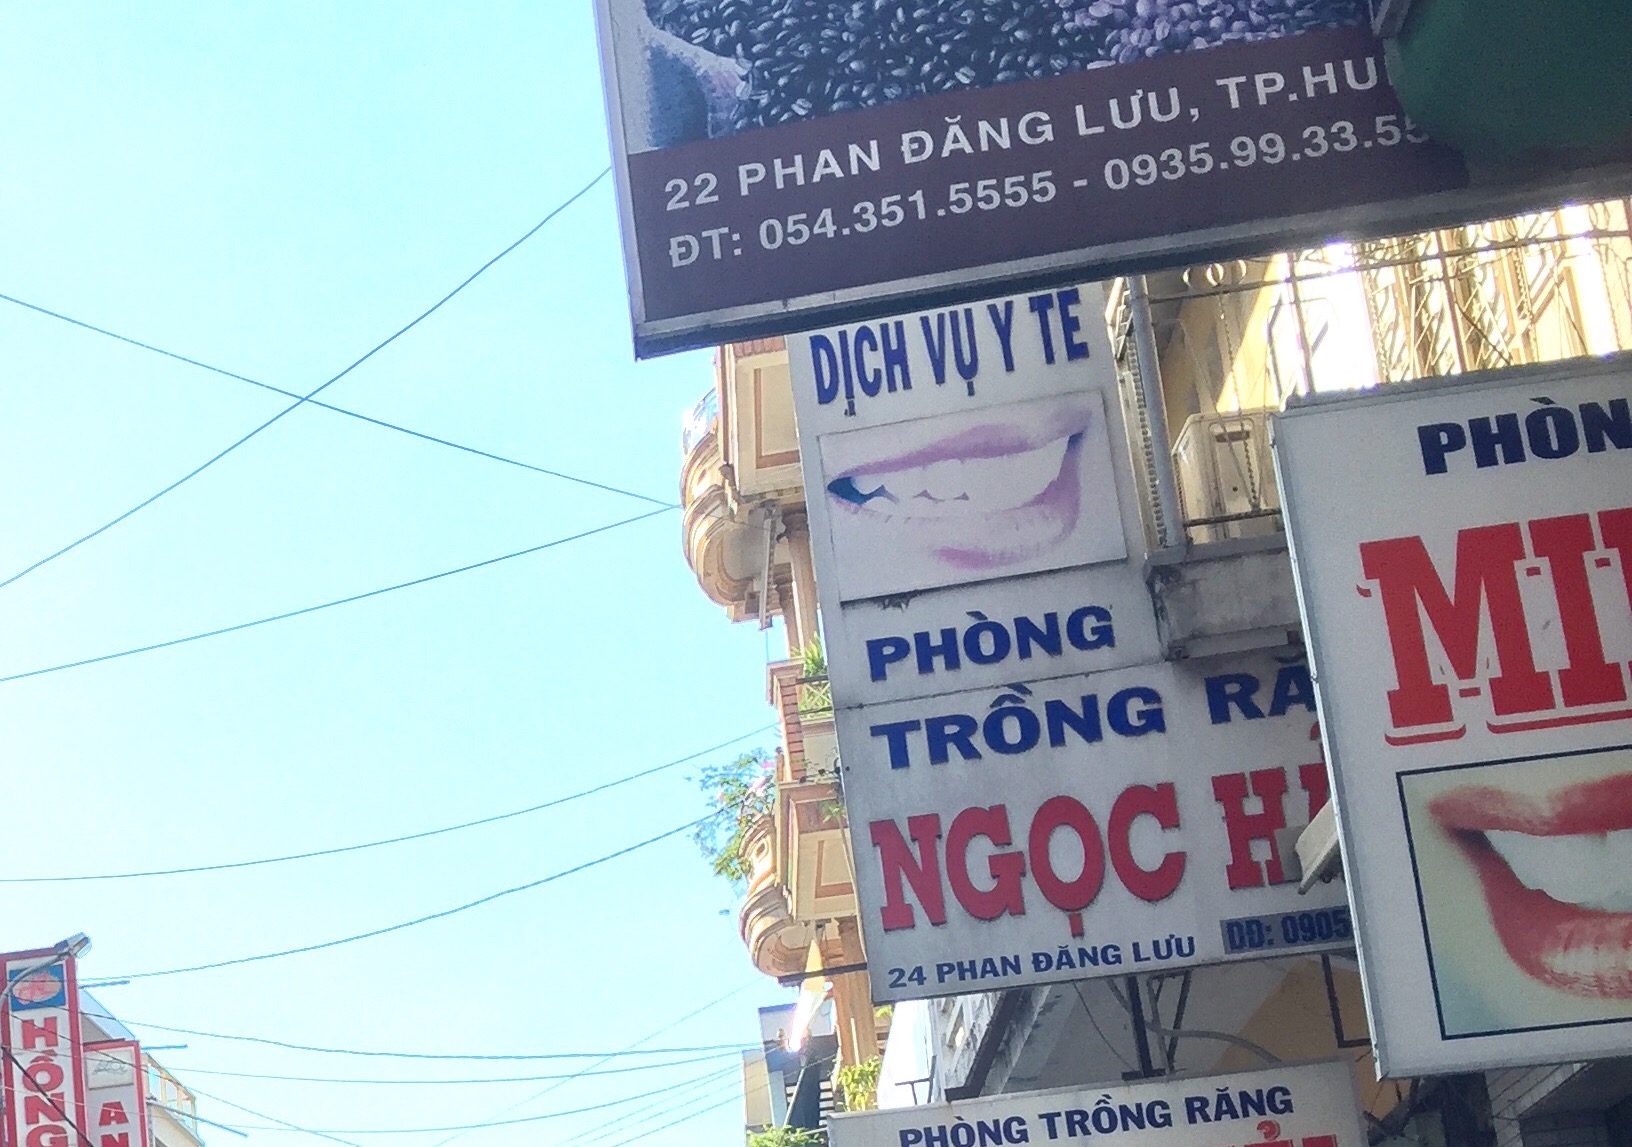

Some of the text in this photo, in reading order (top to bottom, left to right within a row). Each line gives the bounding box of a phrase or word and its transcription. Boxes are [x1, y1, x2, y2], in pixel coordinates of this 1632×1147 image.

[664, 171, 719, 211] 22
[737, 140, 880, 196] PHAN
[900, 110, 1055, 166] ĐĂNG
[667, 170, 1058, 270] ĐT: 054.351.5555
[810, 300, 1014, 417] DỊCH VỤ Y
[1416, 396, 1632, 476] PHÒN
[866, 605, 1116, 681] PHÒNG
[870, 682, 1167, 770] TRỒNG
[870, 781, 1186, 937] NGỌC
[888, 933, 1196, 988] 24 PHAN ĐĂNG LƯU
[1281, 905, 1352, 945] 0905
[1039, 1093, 1172, 1142] TRỒNG
[1186, 1084, 1293, 1125] RĂNG
